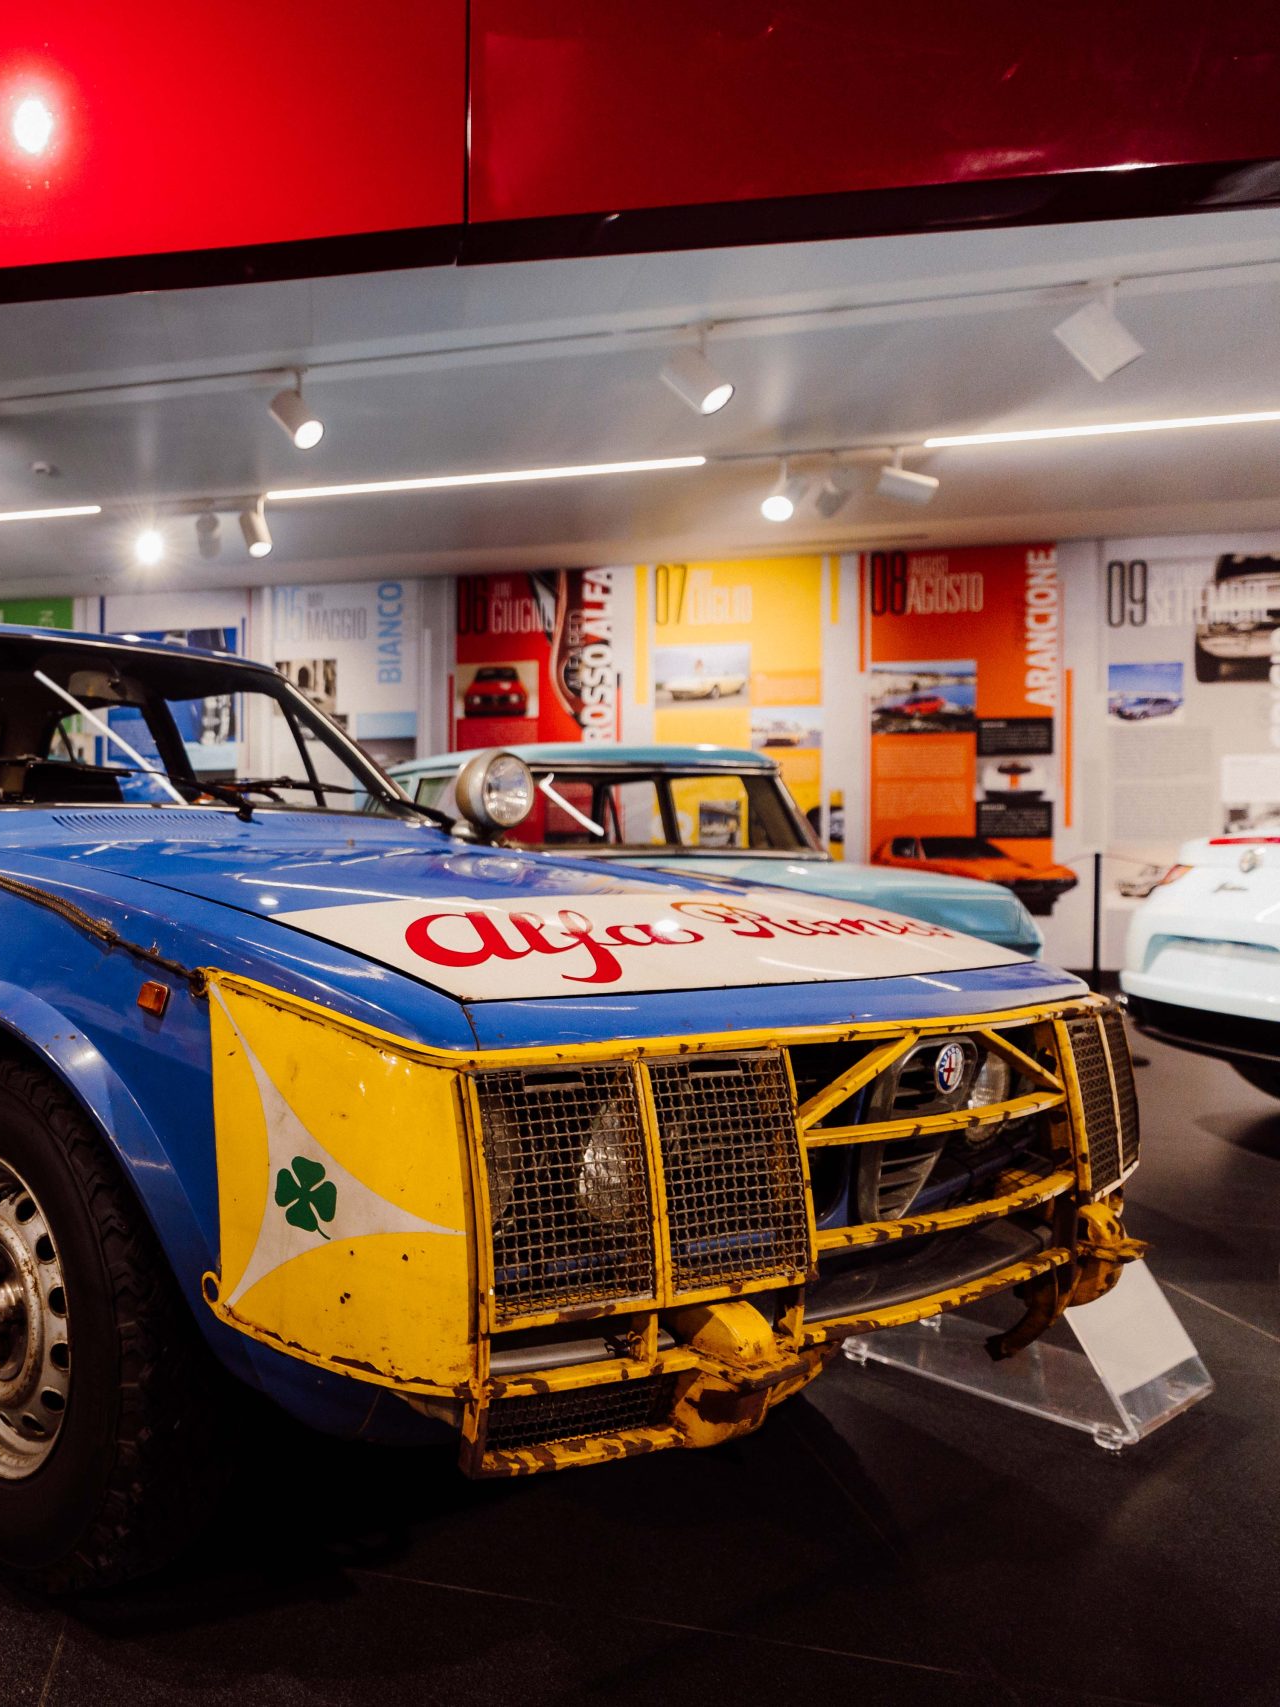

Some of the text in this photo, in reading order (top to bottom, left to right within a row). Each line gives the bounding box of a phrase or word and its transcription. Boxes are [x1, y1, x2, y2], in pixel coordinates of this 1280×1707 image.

[655, 564, 687, 626] 07
[872, 551, 908, 617] 08
[906, 571, 984, 615] AGOSTO
[1108, 560, 1148, 628] 09
[306, 607, 368, 641] MAGGIO
[377, 581, 403, 685] BIANCO
[580, 567, 614, 743] ROSSO ALFA
[1025, 549, 1057, 708] ARANCIONE
[405, 901, 953, 984] Alfa Romeo
